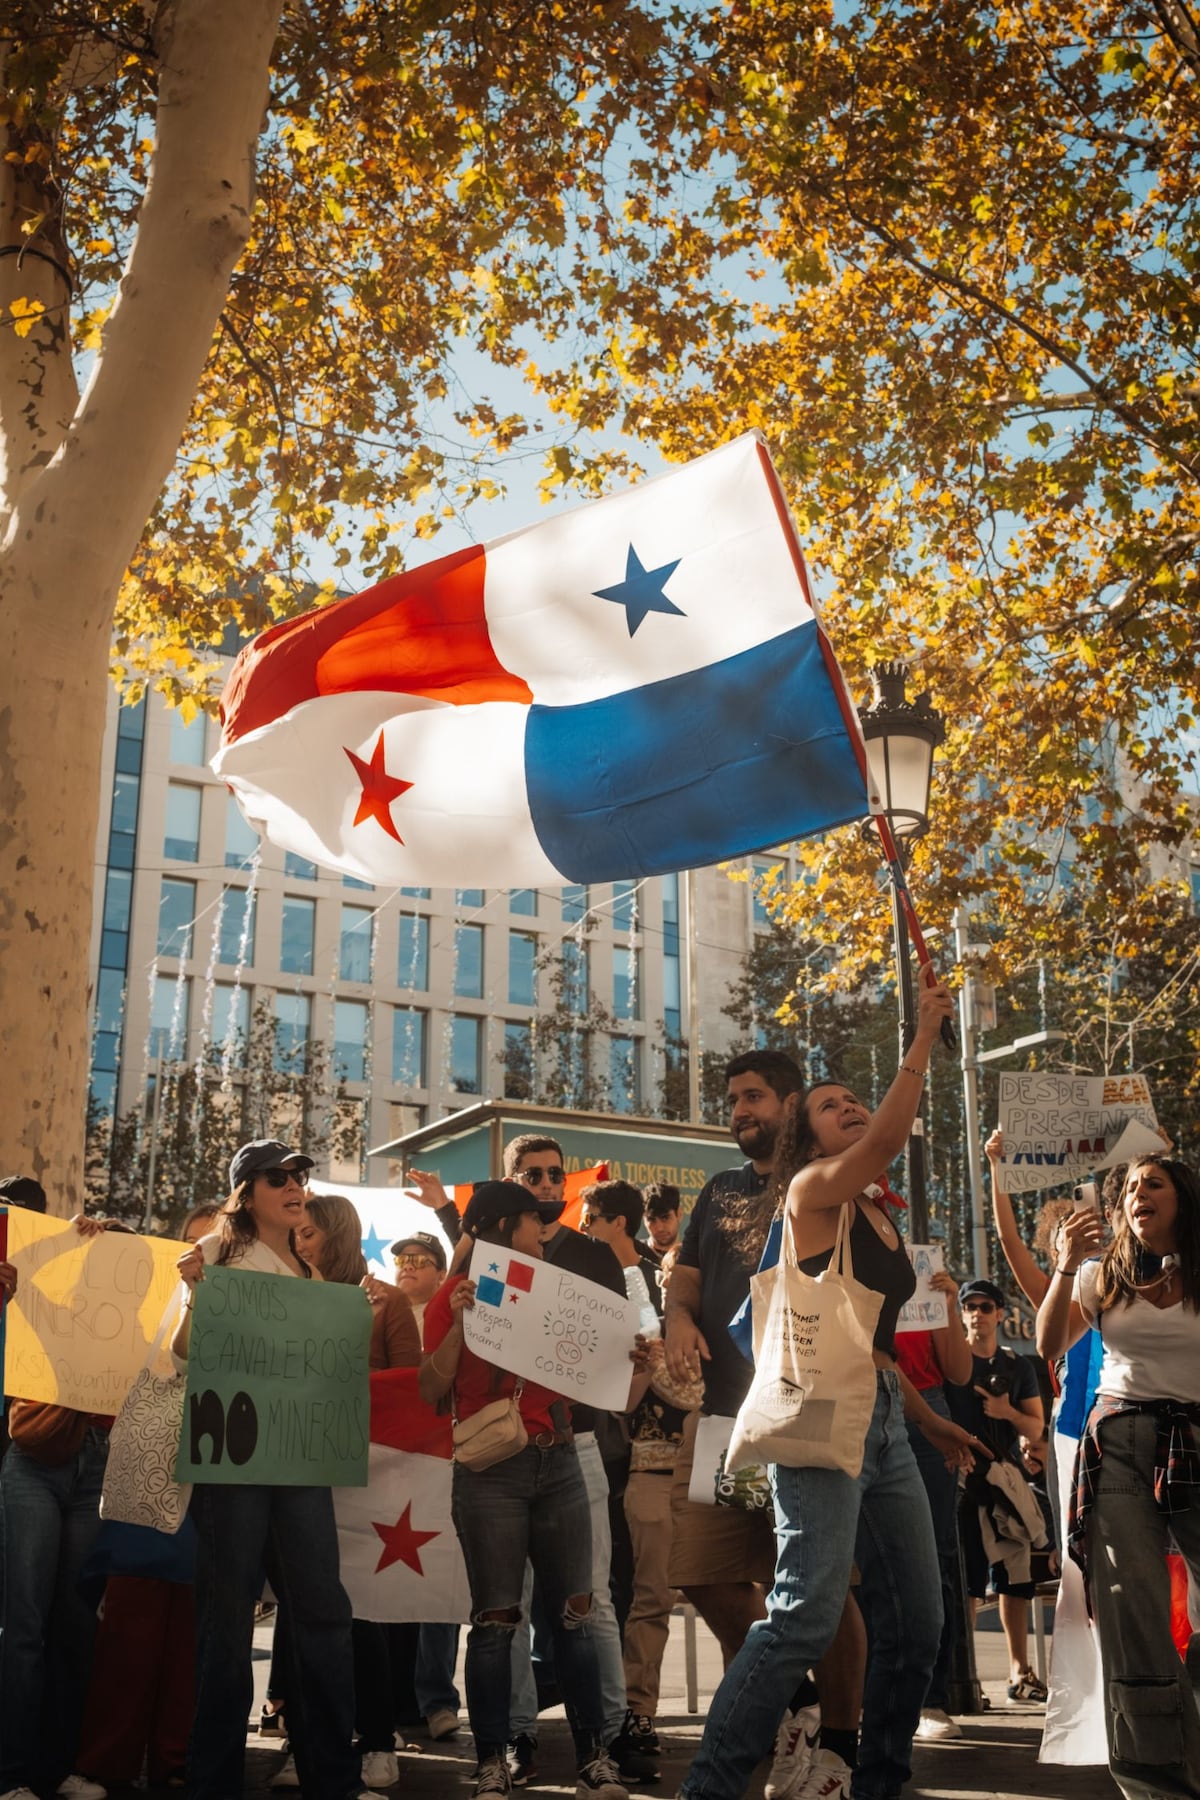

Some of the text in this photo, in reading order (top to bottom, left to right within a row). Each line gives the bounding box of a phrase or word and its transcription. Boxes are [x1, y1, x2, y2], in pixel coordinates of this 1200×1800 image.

[1001, 1077, 1149, 1106] DESDE BCN
[625, 1161, 706, 1188] TICKETLESS
[1003, 1169, 1047, 1191] NO
[208, 1275, 288, 1321] SOMOS
[557, 1273, 625, 1323] Panamá
[558, 1303, 592, 1327] vale
[551, 1319, 590, 1347] ORO
[198, 1329, 352, 1383] CANALEROS
[558, 1343, 579, 1360] NO
[265, 1397, 365, 1463] MINEROS
